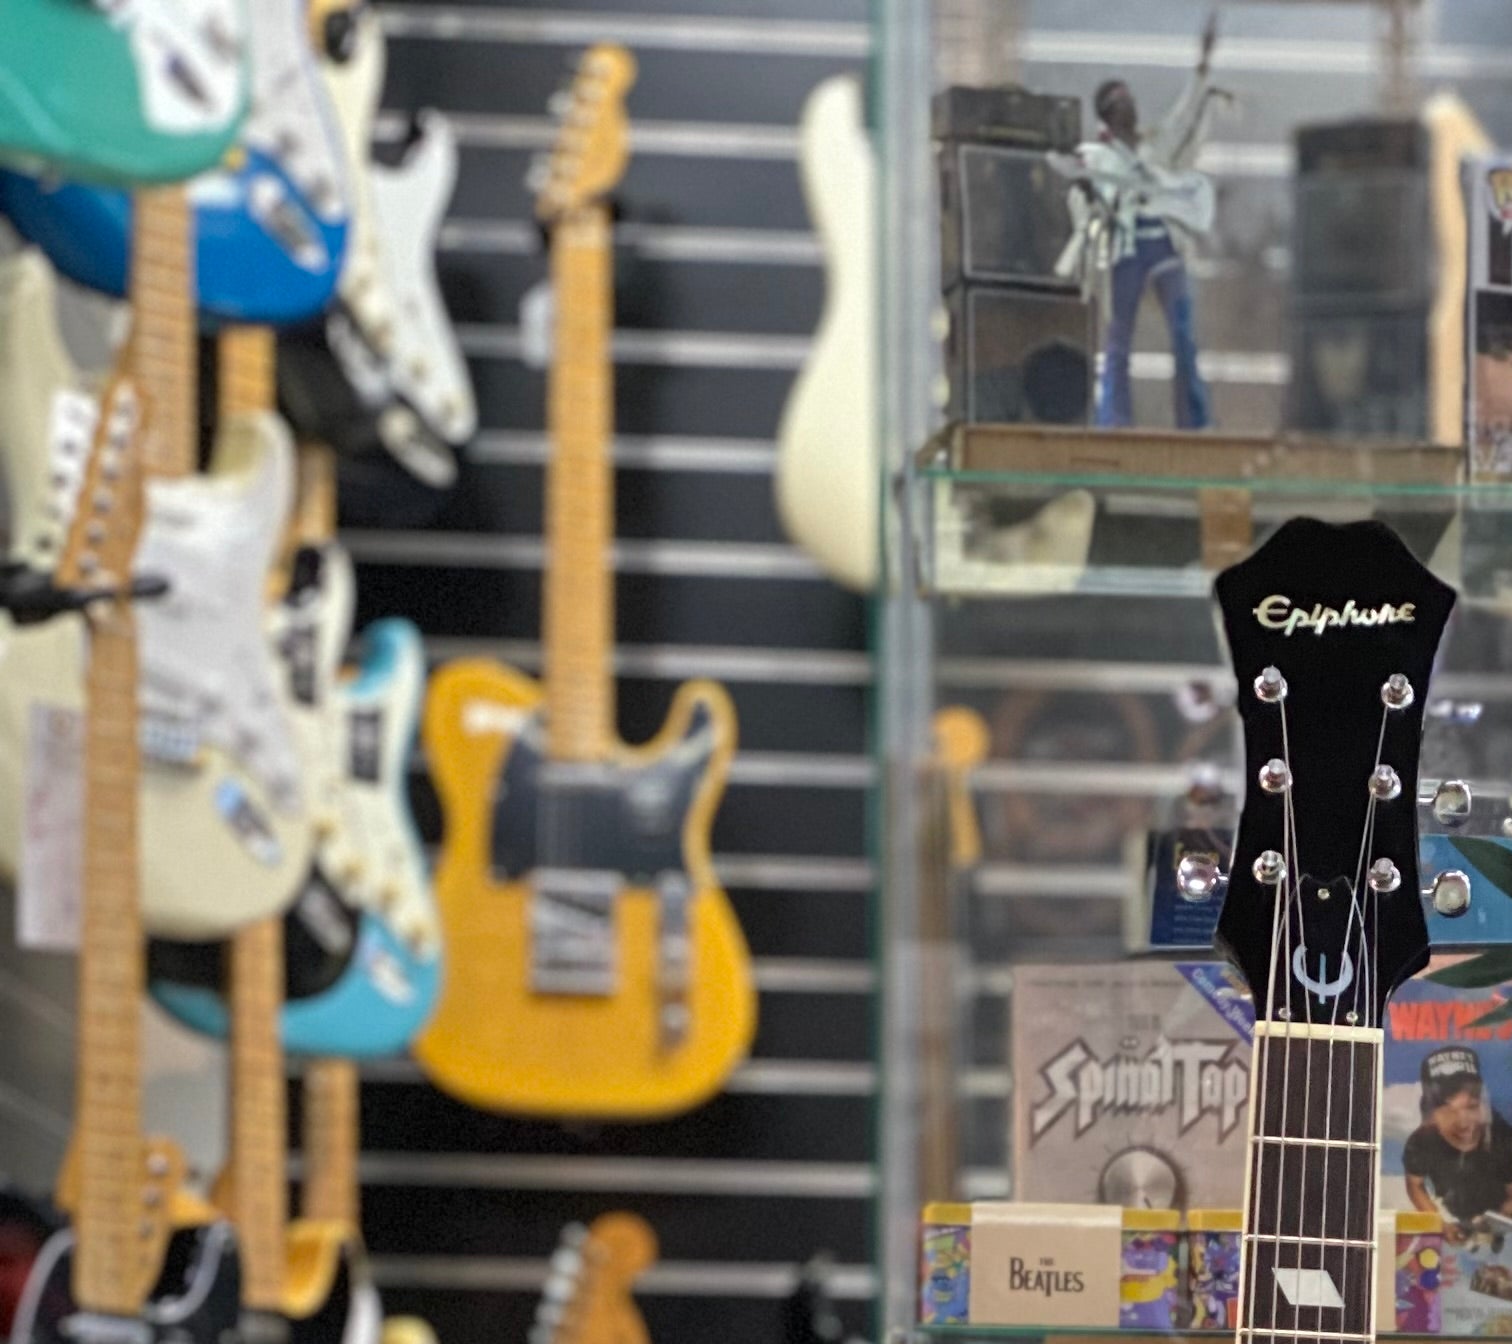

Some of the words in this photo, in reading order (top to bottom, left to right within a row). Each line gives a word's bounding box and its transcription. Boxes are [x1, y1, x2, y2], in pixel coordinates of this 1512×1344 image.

[1253, 595, 1416, 636] Epiphone
[1167, 1038, 1249, 1146] Tap
[1010, 1257, 1084, 1297] BEATLES
